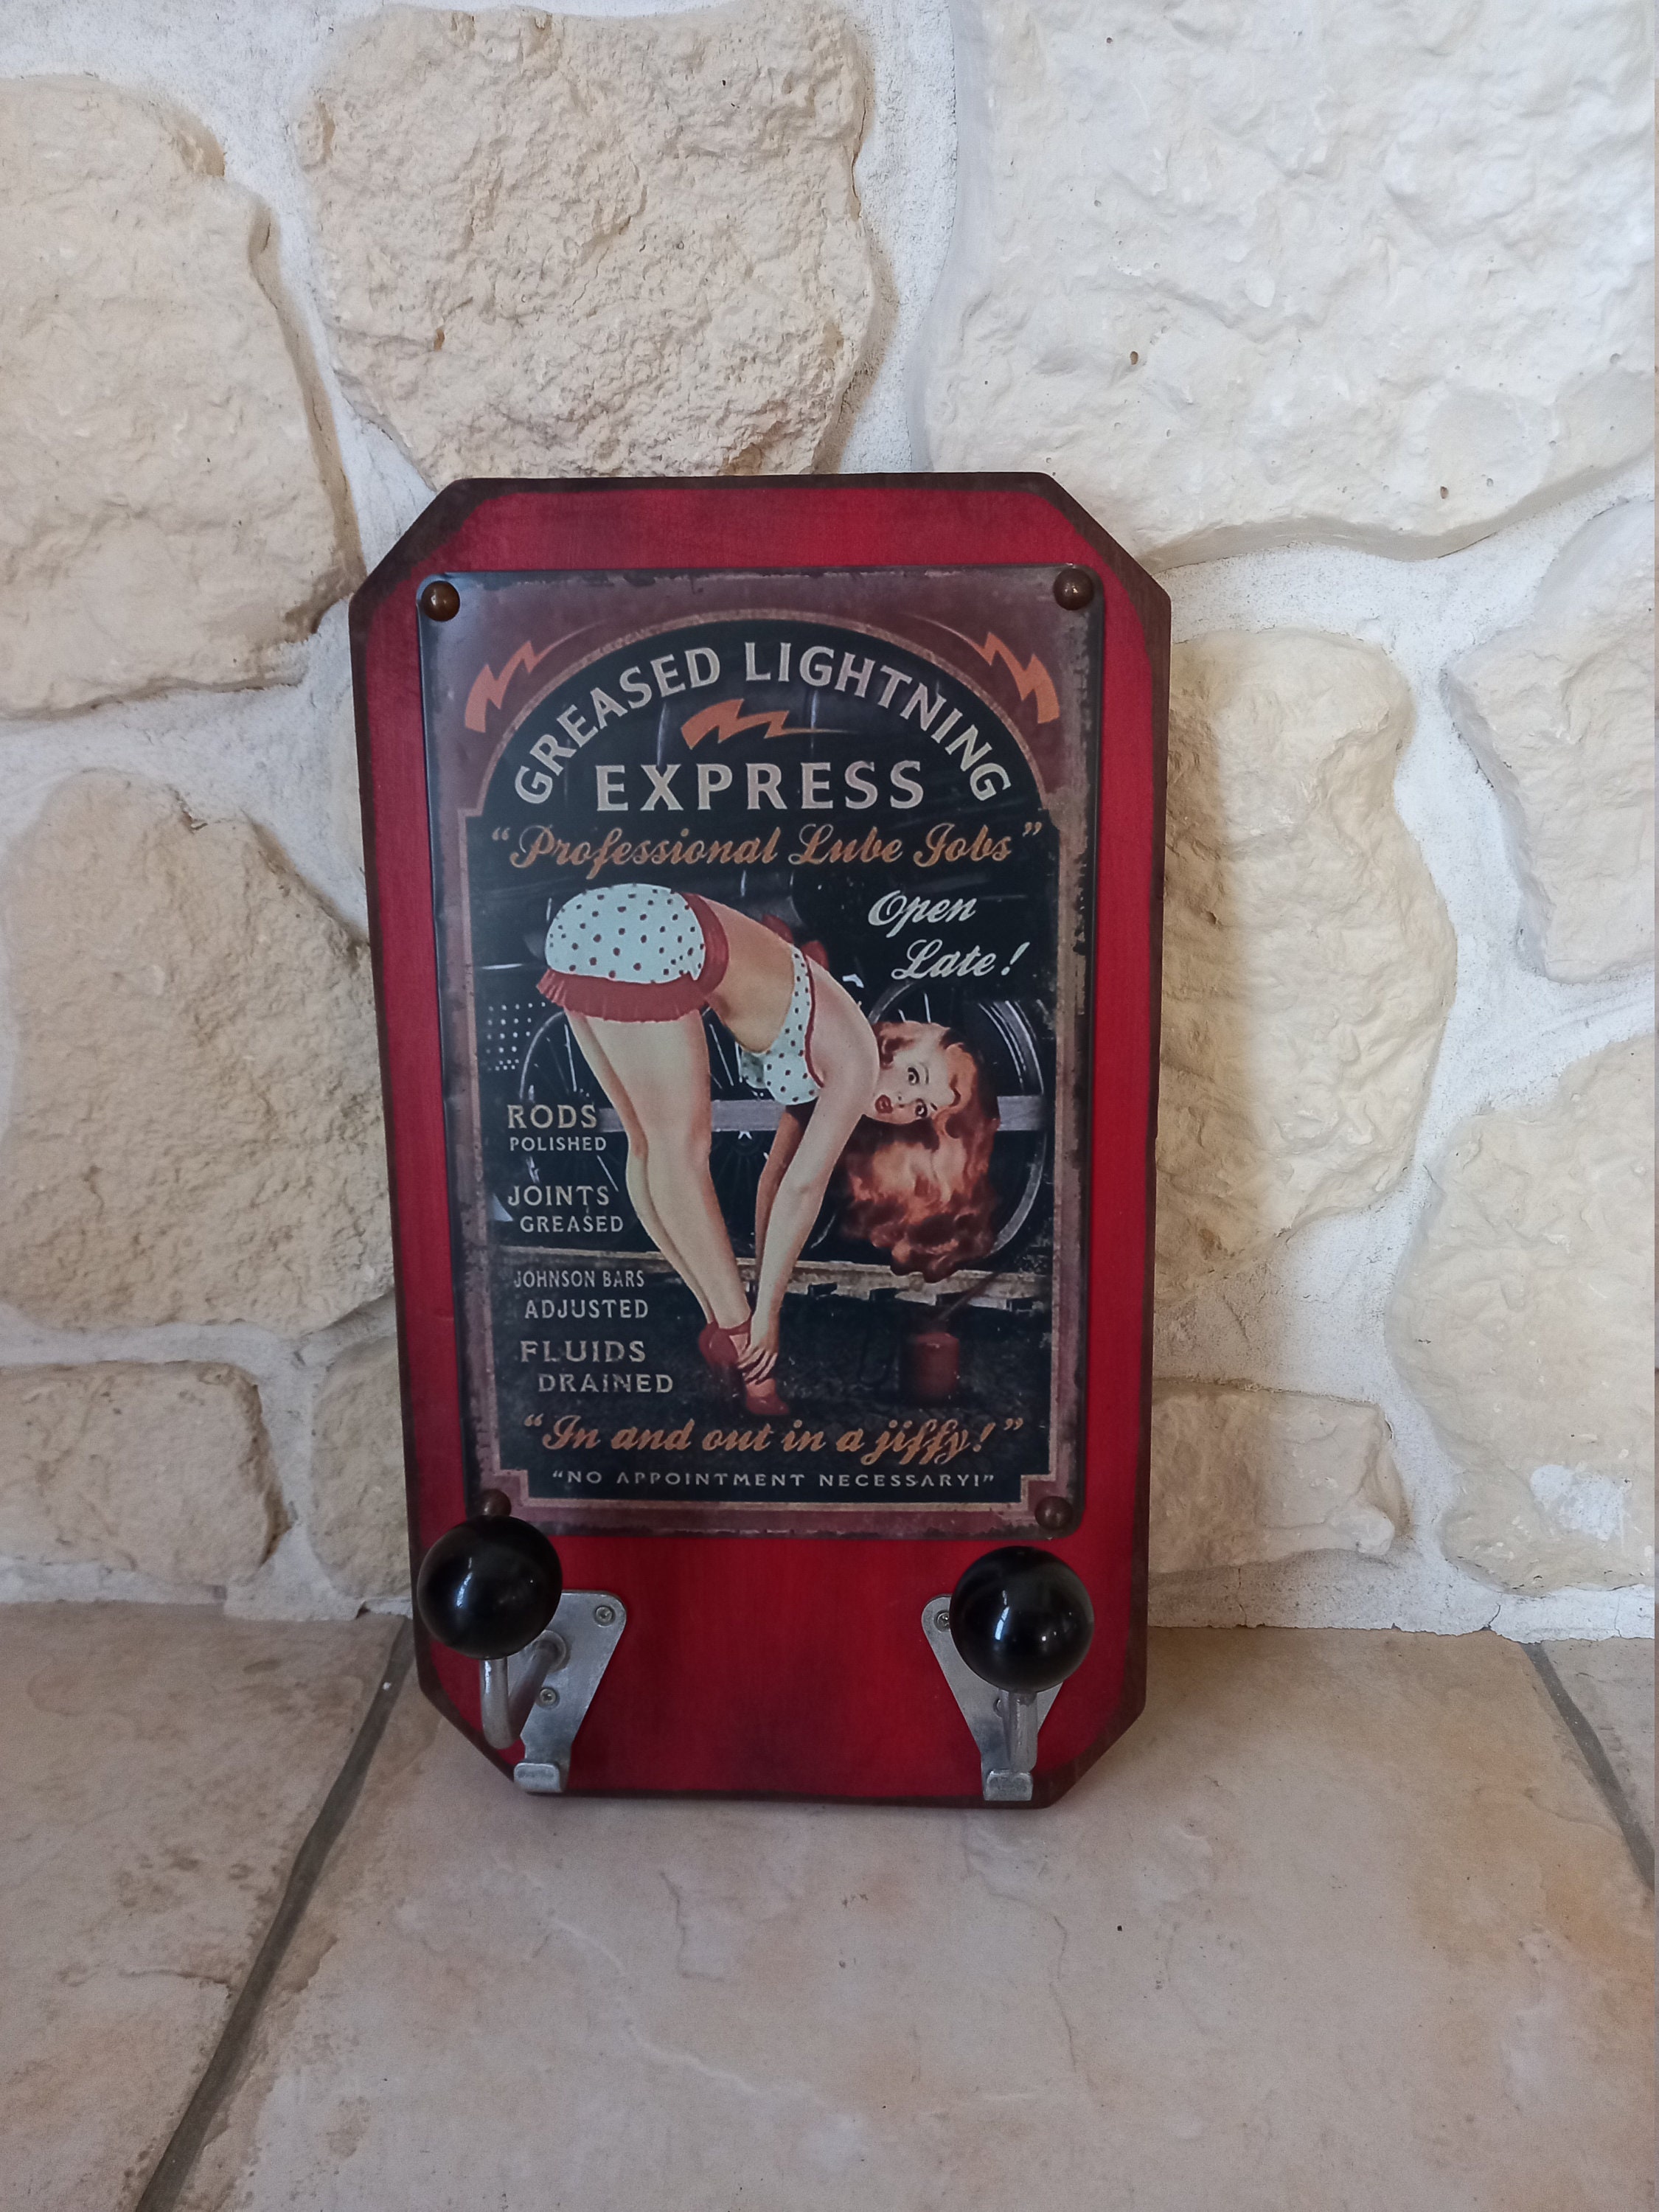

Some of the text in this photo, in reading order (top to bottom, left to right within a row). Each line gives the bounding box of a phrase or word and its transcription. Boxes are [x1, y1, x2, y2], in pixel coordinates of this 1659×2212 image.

[514, 641, 1012, 804] GREASED LIGHTNING
[595, 759, 924, 811] EXPRESS
[491, 824, 779, 880] “Professional
[787, 824, 903, 865] Lube
[867, 889, 978, 939] Open
[507, 1105, 598, 1130] RODS
[509, 1136, 607, 1152] POLISHED
[507, 1185, 610, 1206] JOINTS
[520, 1216, 624, 1233] GREASED
[515, 1270, 645, 1288] JOHNSON BARS
[524, 1299, 649, 1319] ADJUSTED
[520, 1340, 646, 1363] FLUIDS
[538, 1374, 674, 1393] DRAINED
[610, 1418, 695, 1451] and
[701, 1422, 775, 1452] out
[781, 1419, 827, 1453] in
[835, 1427, 865, 1453] a
[552, 1471, 602, 1484] “NO
[616, 1472, 805, 1487] APPOINTMENT
